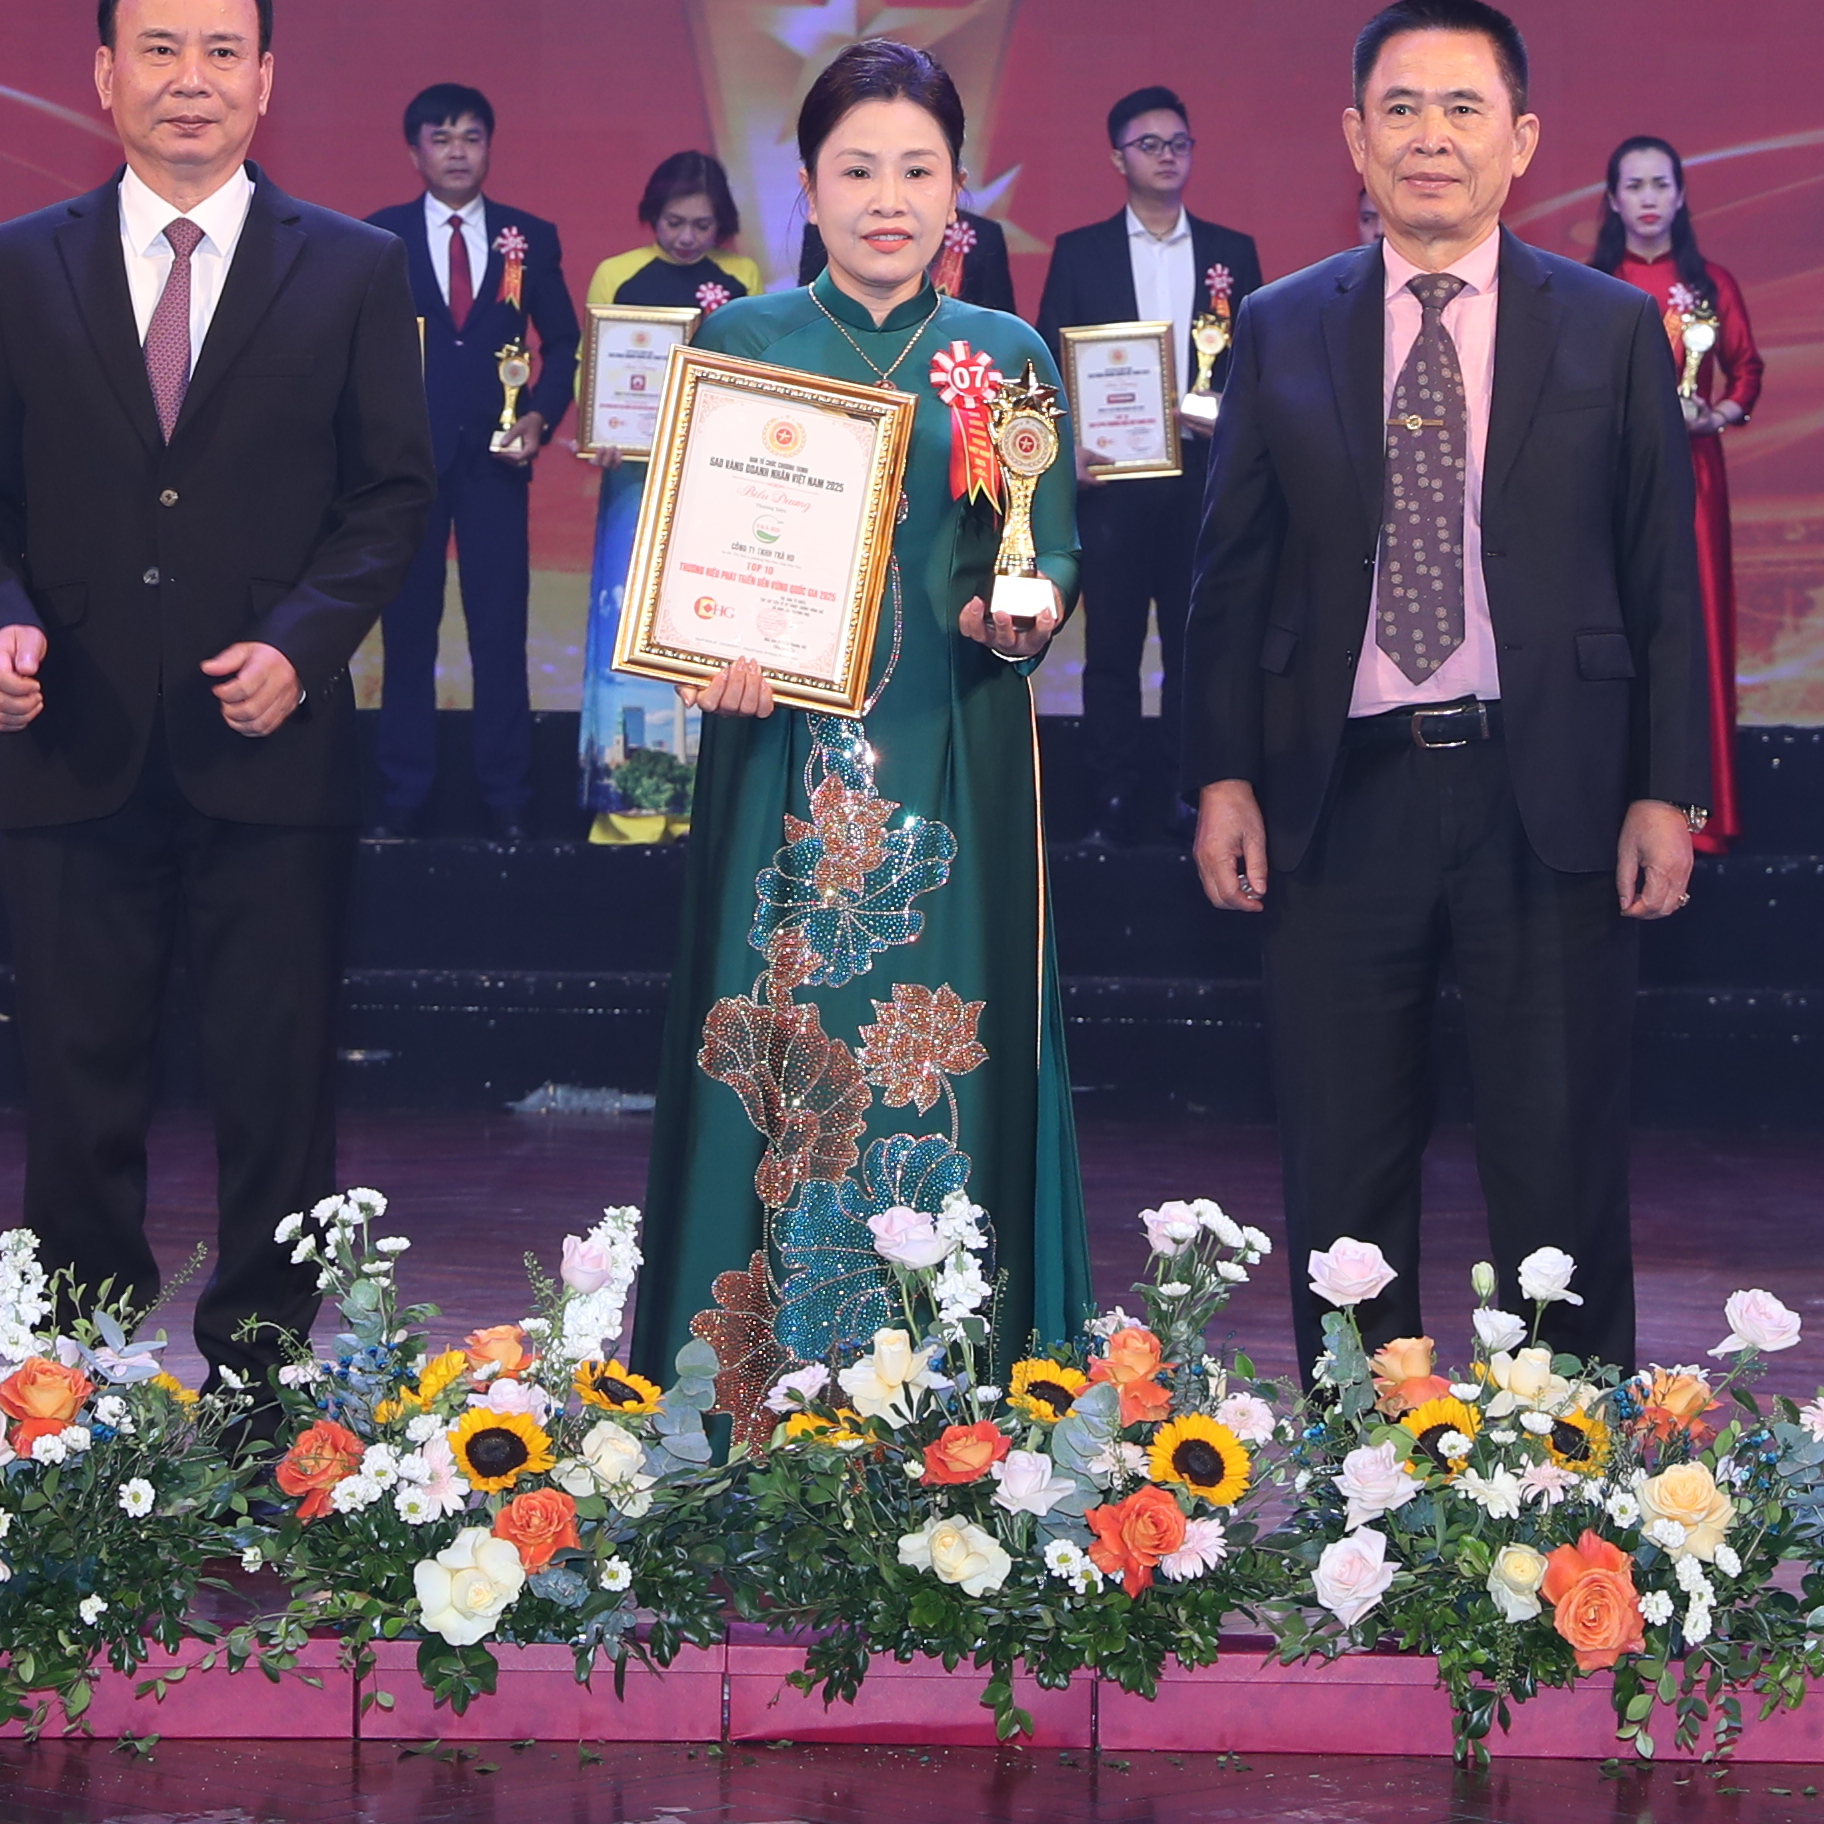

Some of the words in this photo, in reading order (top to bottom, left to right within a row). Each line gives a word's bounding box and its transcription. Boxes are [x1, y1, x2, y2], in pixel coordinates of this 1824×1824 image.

[952, 366, 985, 389] 07
[710, 456, 724, 468] SAO
[808, 476, 824, 489] NAM
[826, 480, 844, 493] 2025
[747, 562, 763, 573] TOP
[765, 565, 774, 576] 10
